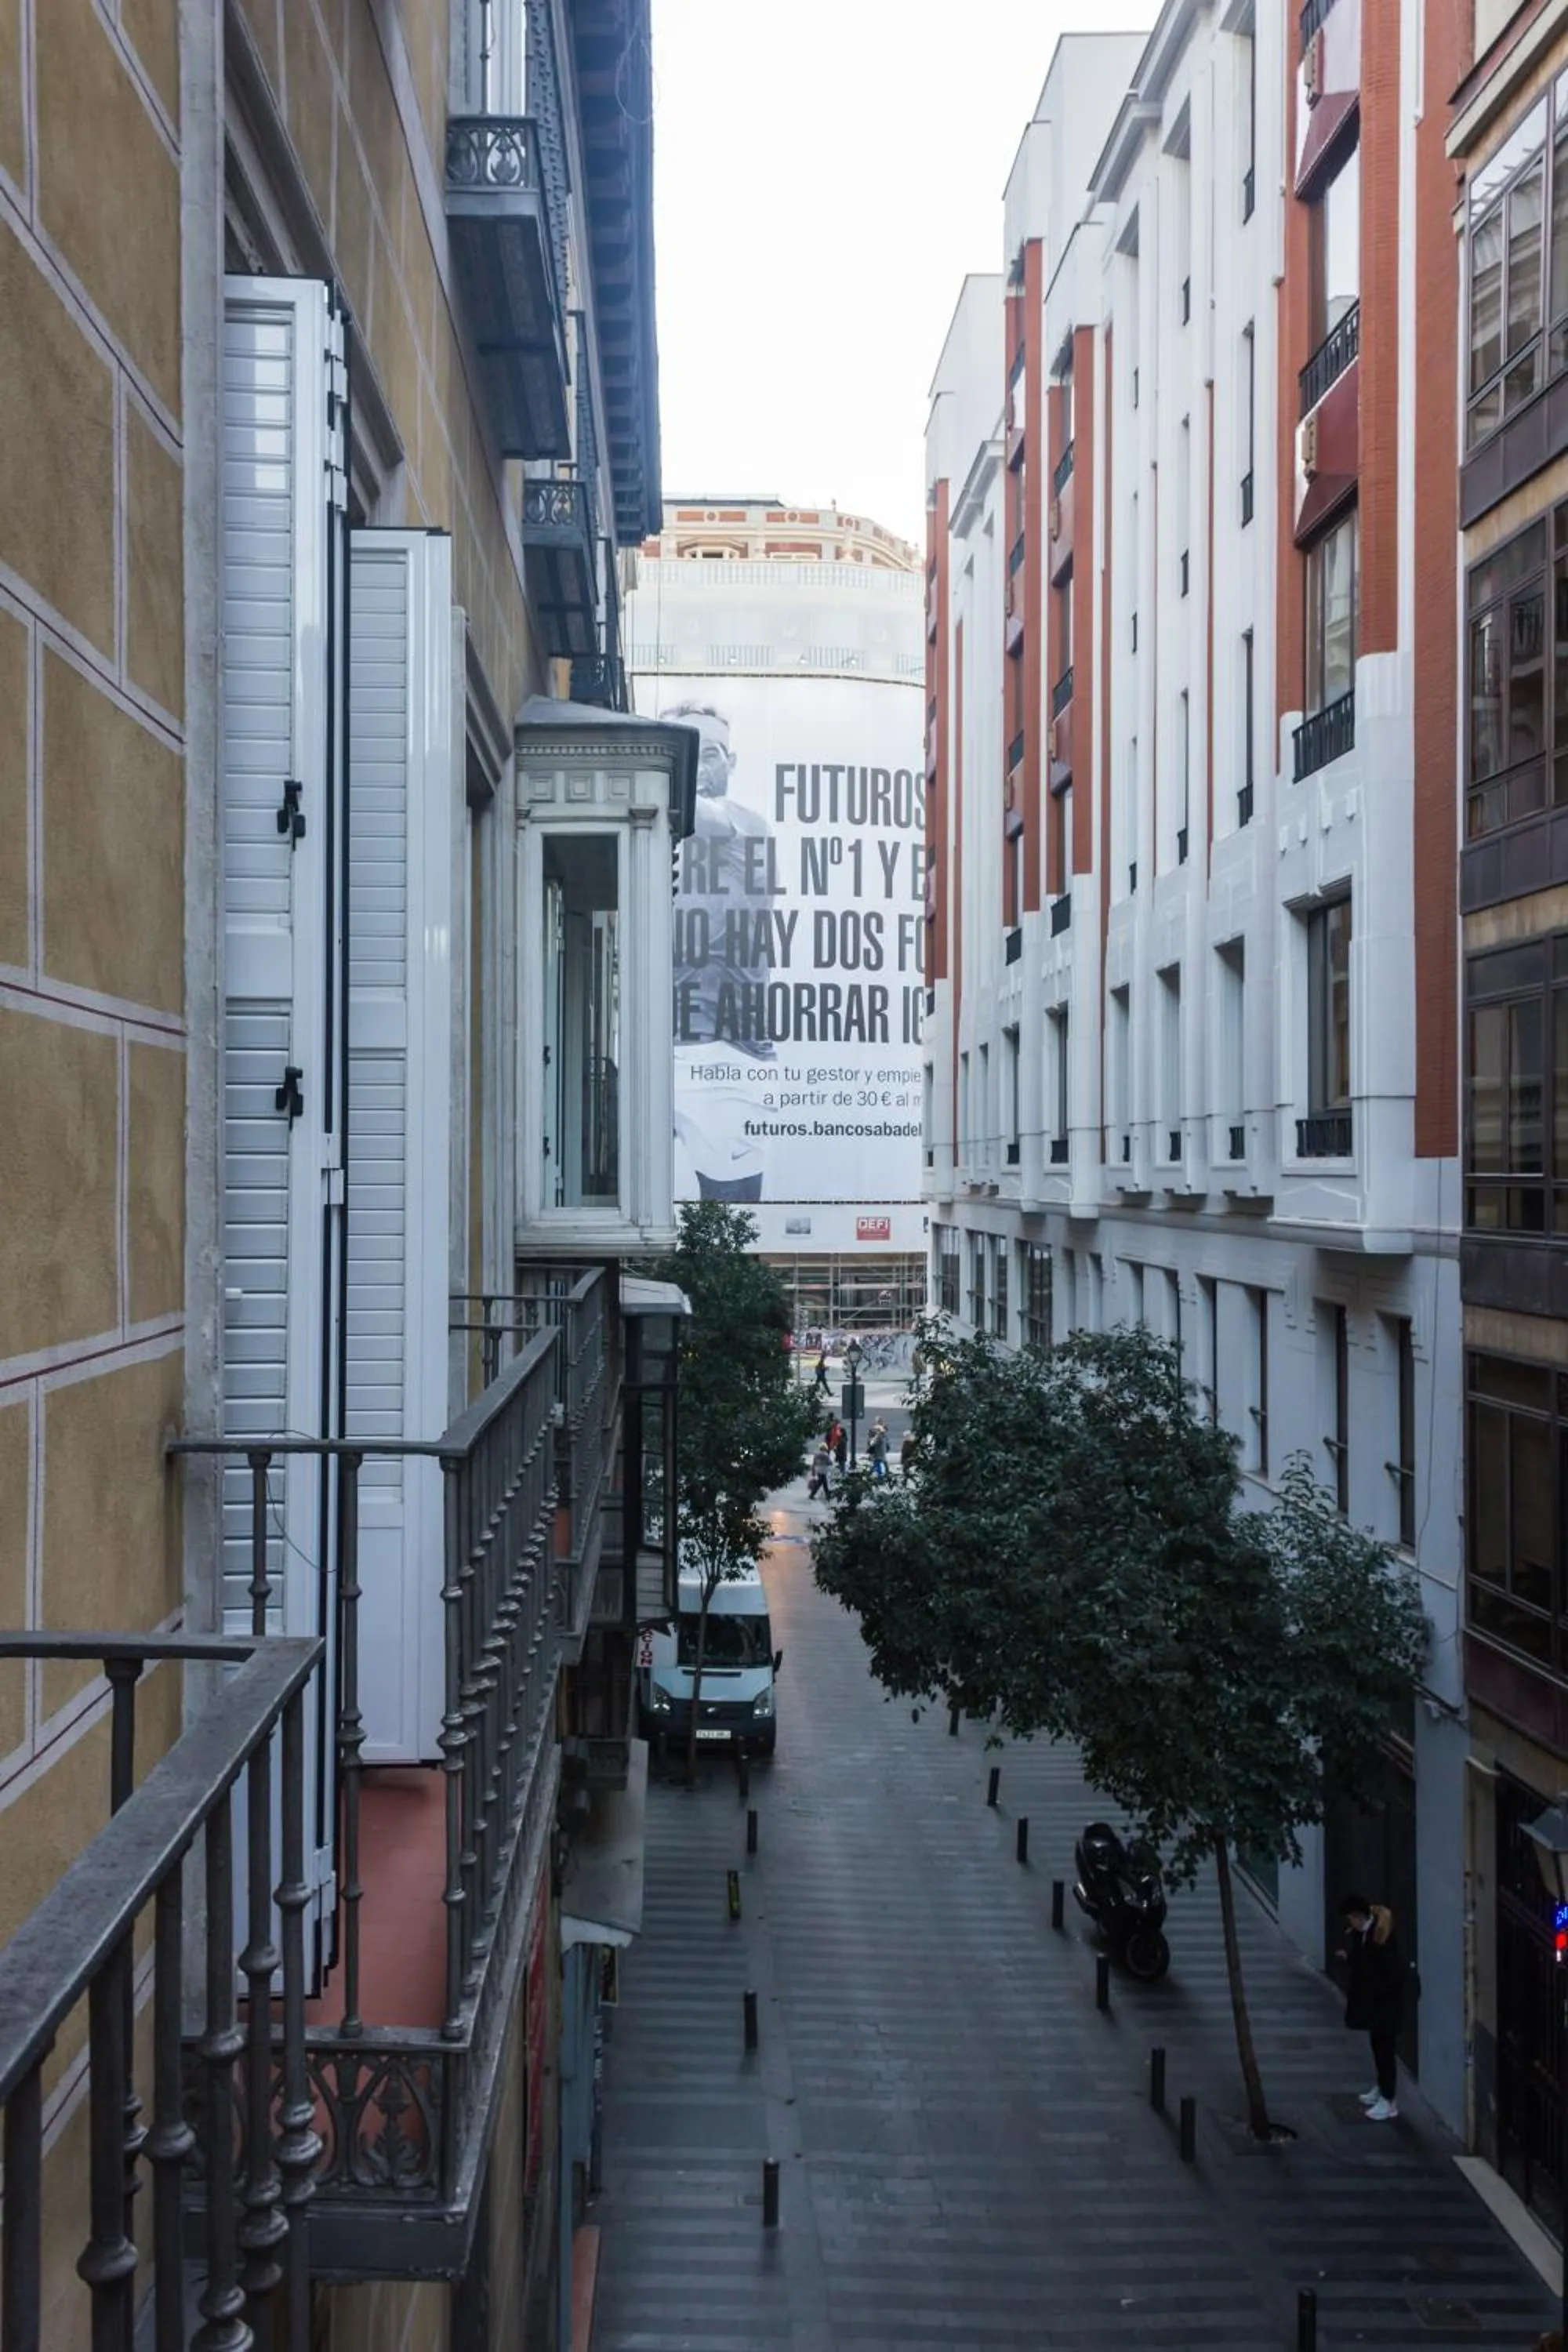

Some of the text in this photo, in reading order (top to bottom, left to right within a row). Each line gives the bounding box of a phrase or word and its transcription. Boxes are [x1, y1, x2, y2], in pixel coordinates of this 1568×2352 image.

[775, 763, 925, 831] FUTUROS
[746, 837, 786, 896] EL
[877, 840, 900, 899] Y
[725, 908, 798, 969] HAY
[814, 910, 884, 971] DOS
[714, 981, 889, 1044] AHORRAR
[690, 1065, 742, 1081] Habla
[746, 1068, 779, 1081] con
[784, 1065, 801, 1081] tu
[807, 1066, 860, 1085] gestor
[864, 1069, 873, 1085] y
[763, 1094, 774, 1105] a
[780, 1091, 828, 1109] partir
[833, 1091, 852, 1105] de
[857, 1091, 877, 1106] 30
[881, 1091, 891, 1106] €
[895, 1091, 909, 1107] al
